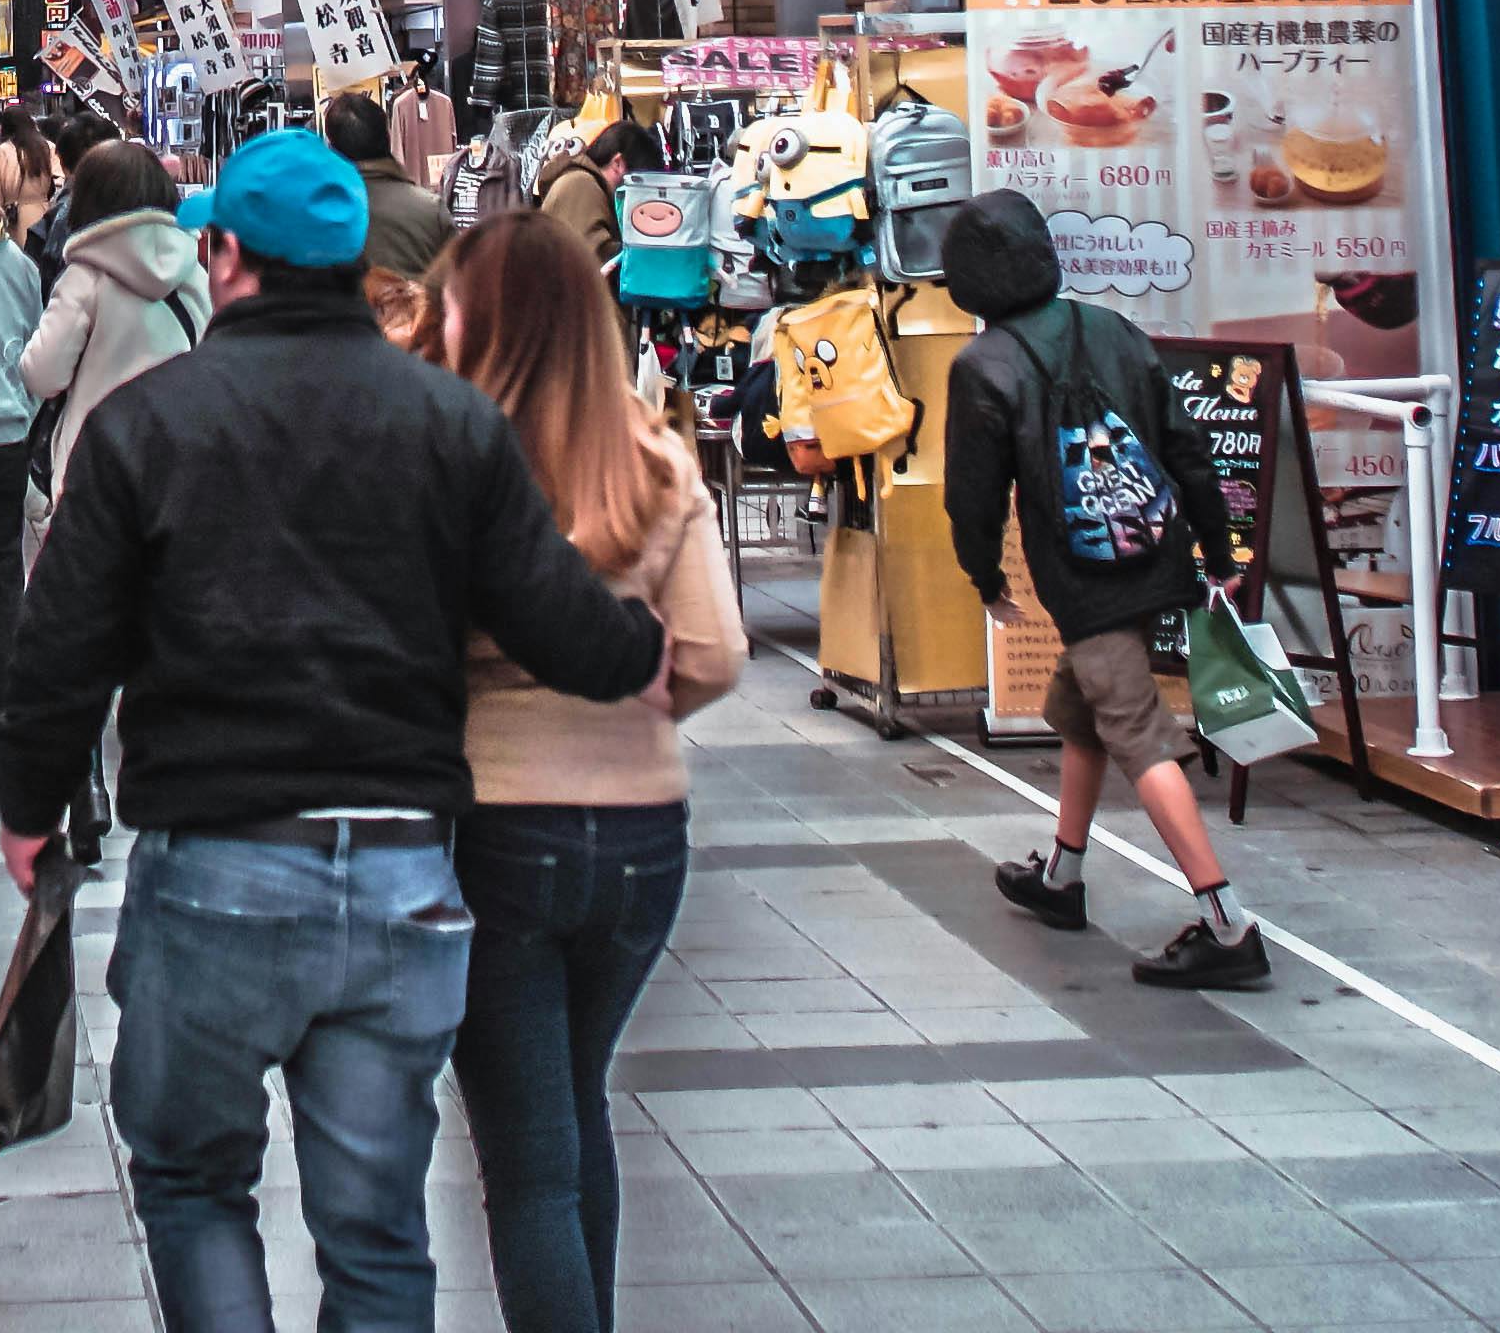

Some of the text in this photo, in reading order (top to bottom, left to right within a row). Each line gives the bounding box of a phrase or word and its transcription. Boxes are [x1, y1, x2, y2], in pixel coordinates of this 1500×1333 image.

[1201, 20, 1400, 47] 国産有機無農薬の
[1237, 51, 1370, 73] ハーブティー
[986, 150, 1056, 169] 薫り高い
[1205, 220, 1298, 239] 国産手摘み
[1246, 241, 1327, 260] カモミール
[1345, 455, 1396, 477] 450
